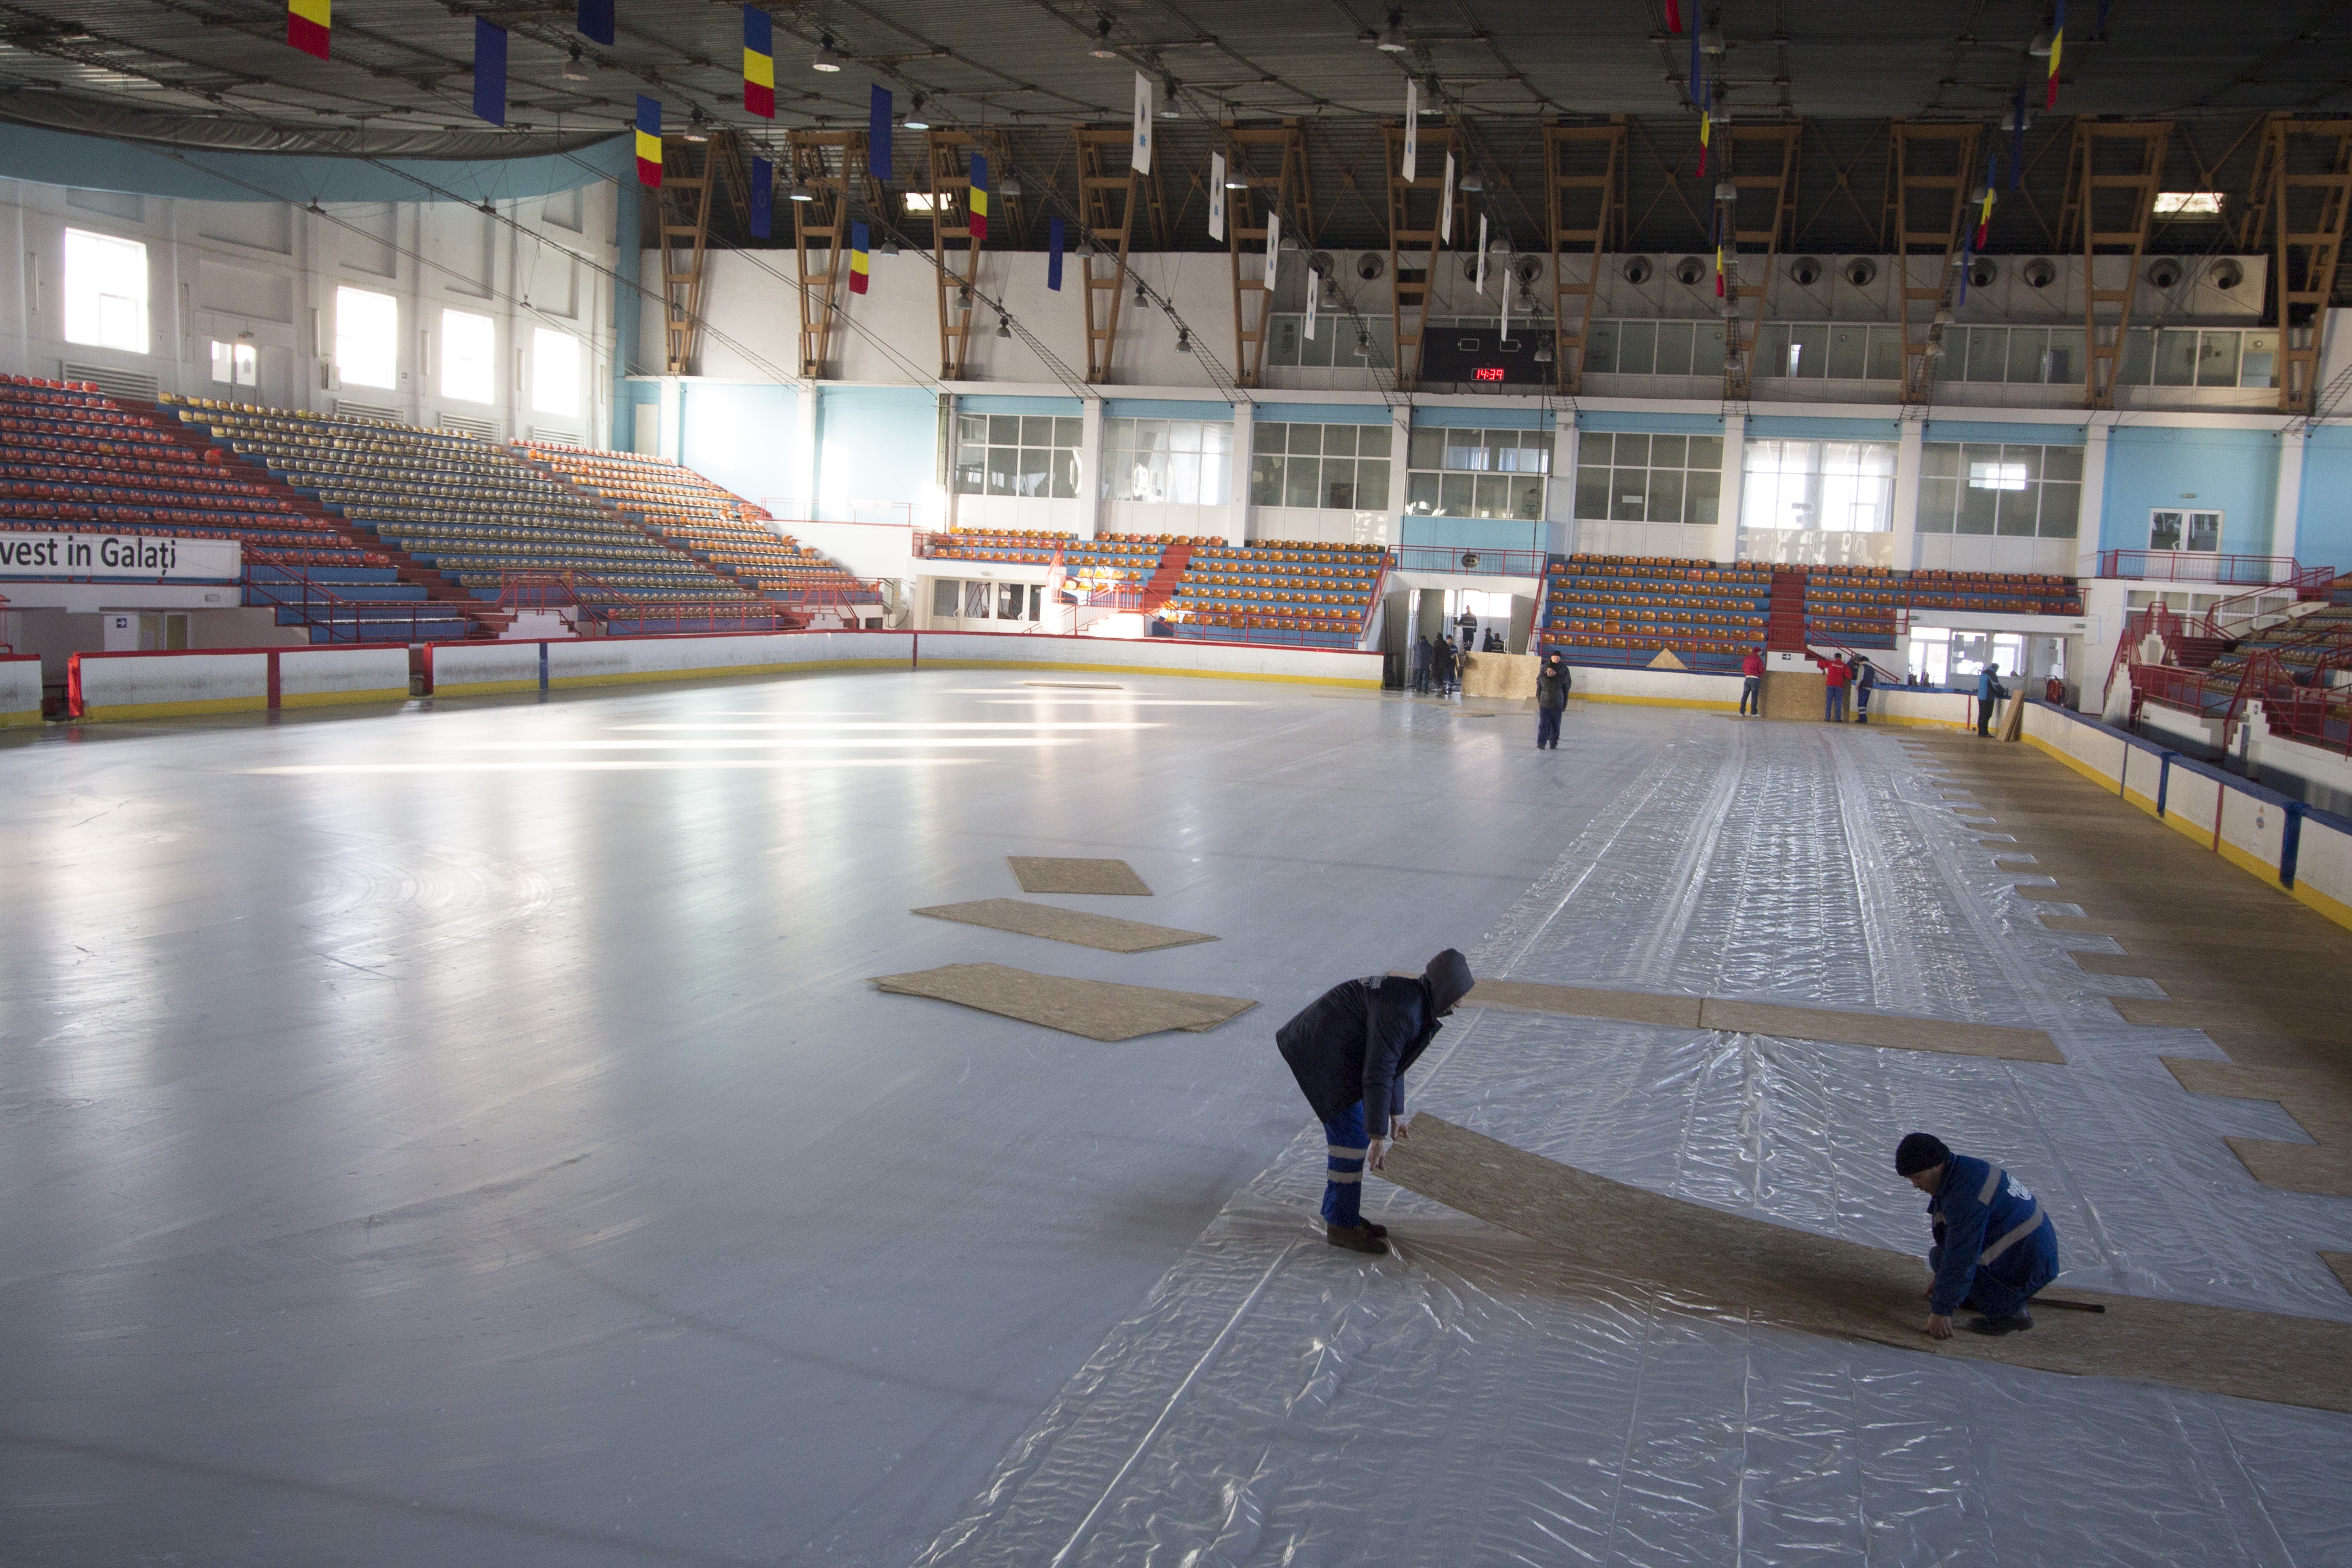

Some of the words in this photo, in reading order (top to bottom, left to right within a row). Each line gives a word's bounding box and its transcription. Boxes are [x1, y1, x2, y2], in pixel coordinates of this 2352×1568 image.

[1477, 368, 1504, 380] 14:39
[0, 538, 58, 565] vest
[68, 535, 91, 566] in
[101, 537, 176, 576] Galați
